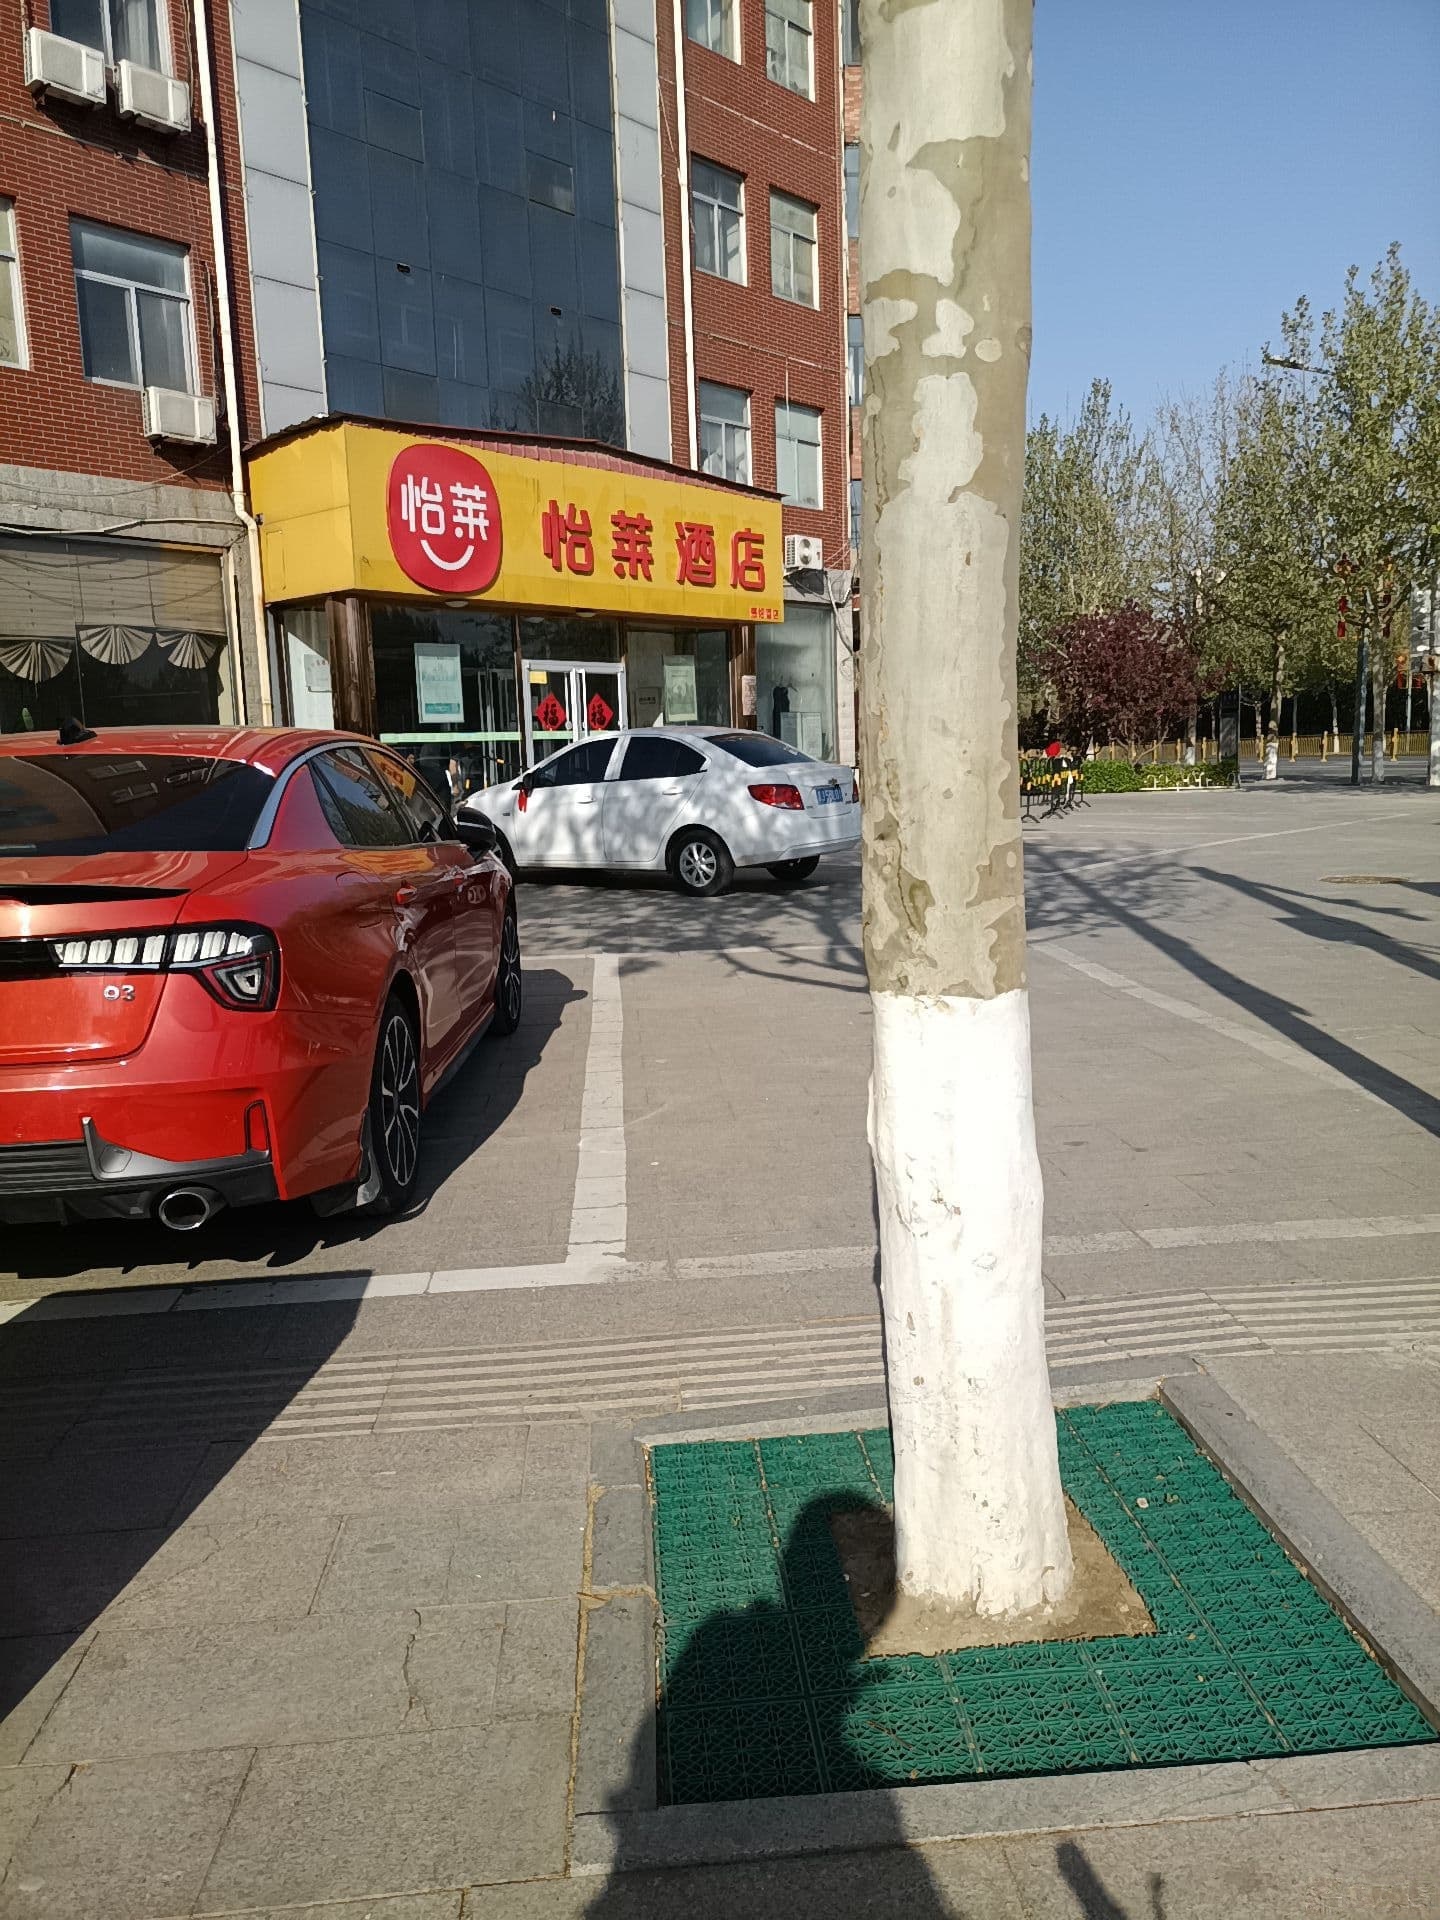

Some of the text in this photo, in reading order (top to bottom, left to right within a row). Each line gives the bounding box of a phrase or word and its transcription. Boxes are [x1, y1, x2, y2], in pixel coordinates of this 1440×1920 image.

[401, 474, 490, 541] 怡莱
[543, 500, 766, 591] 怡莱酒店
[543, 703, 559, 726] 福
[590, 703, 606, 726] 福
[104, 984, 135, 1001] 03
